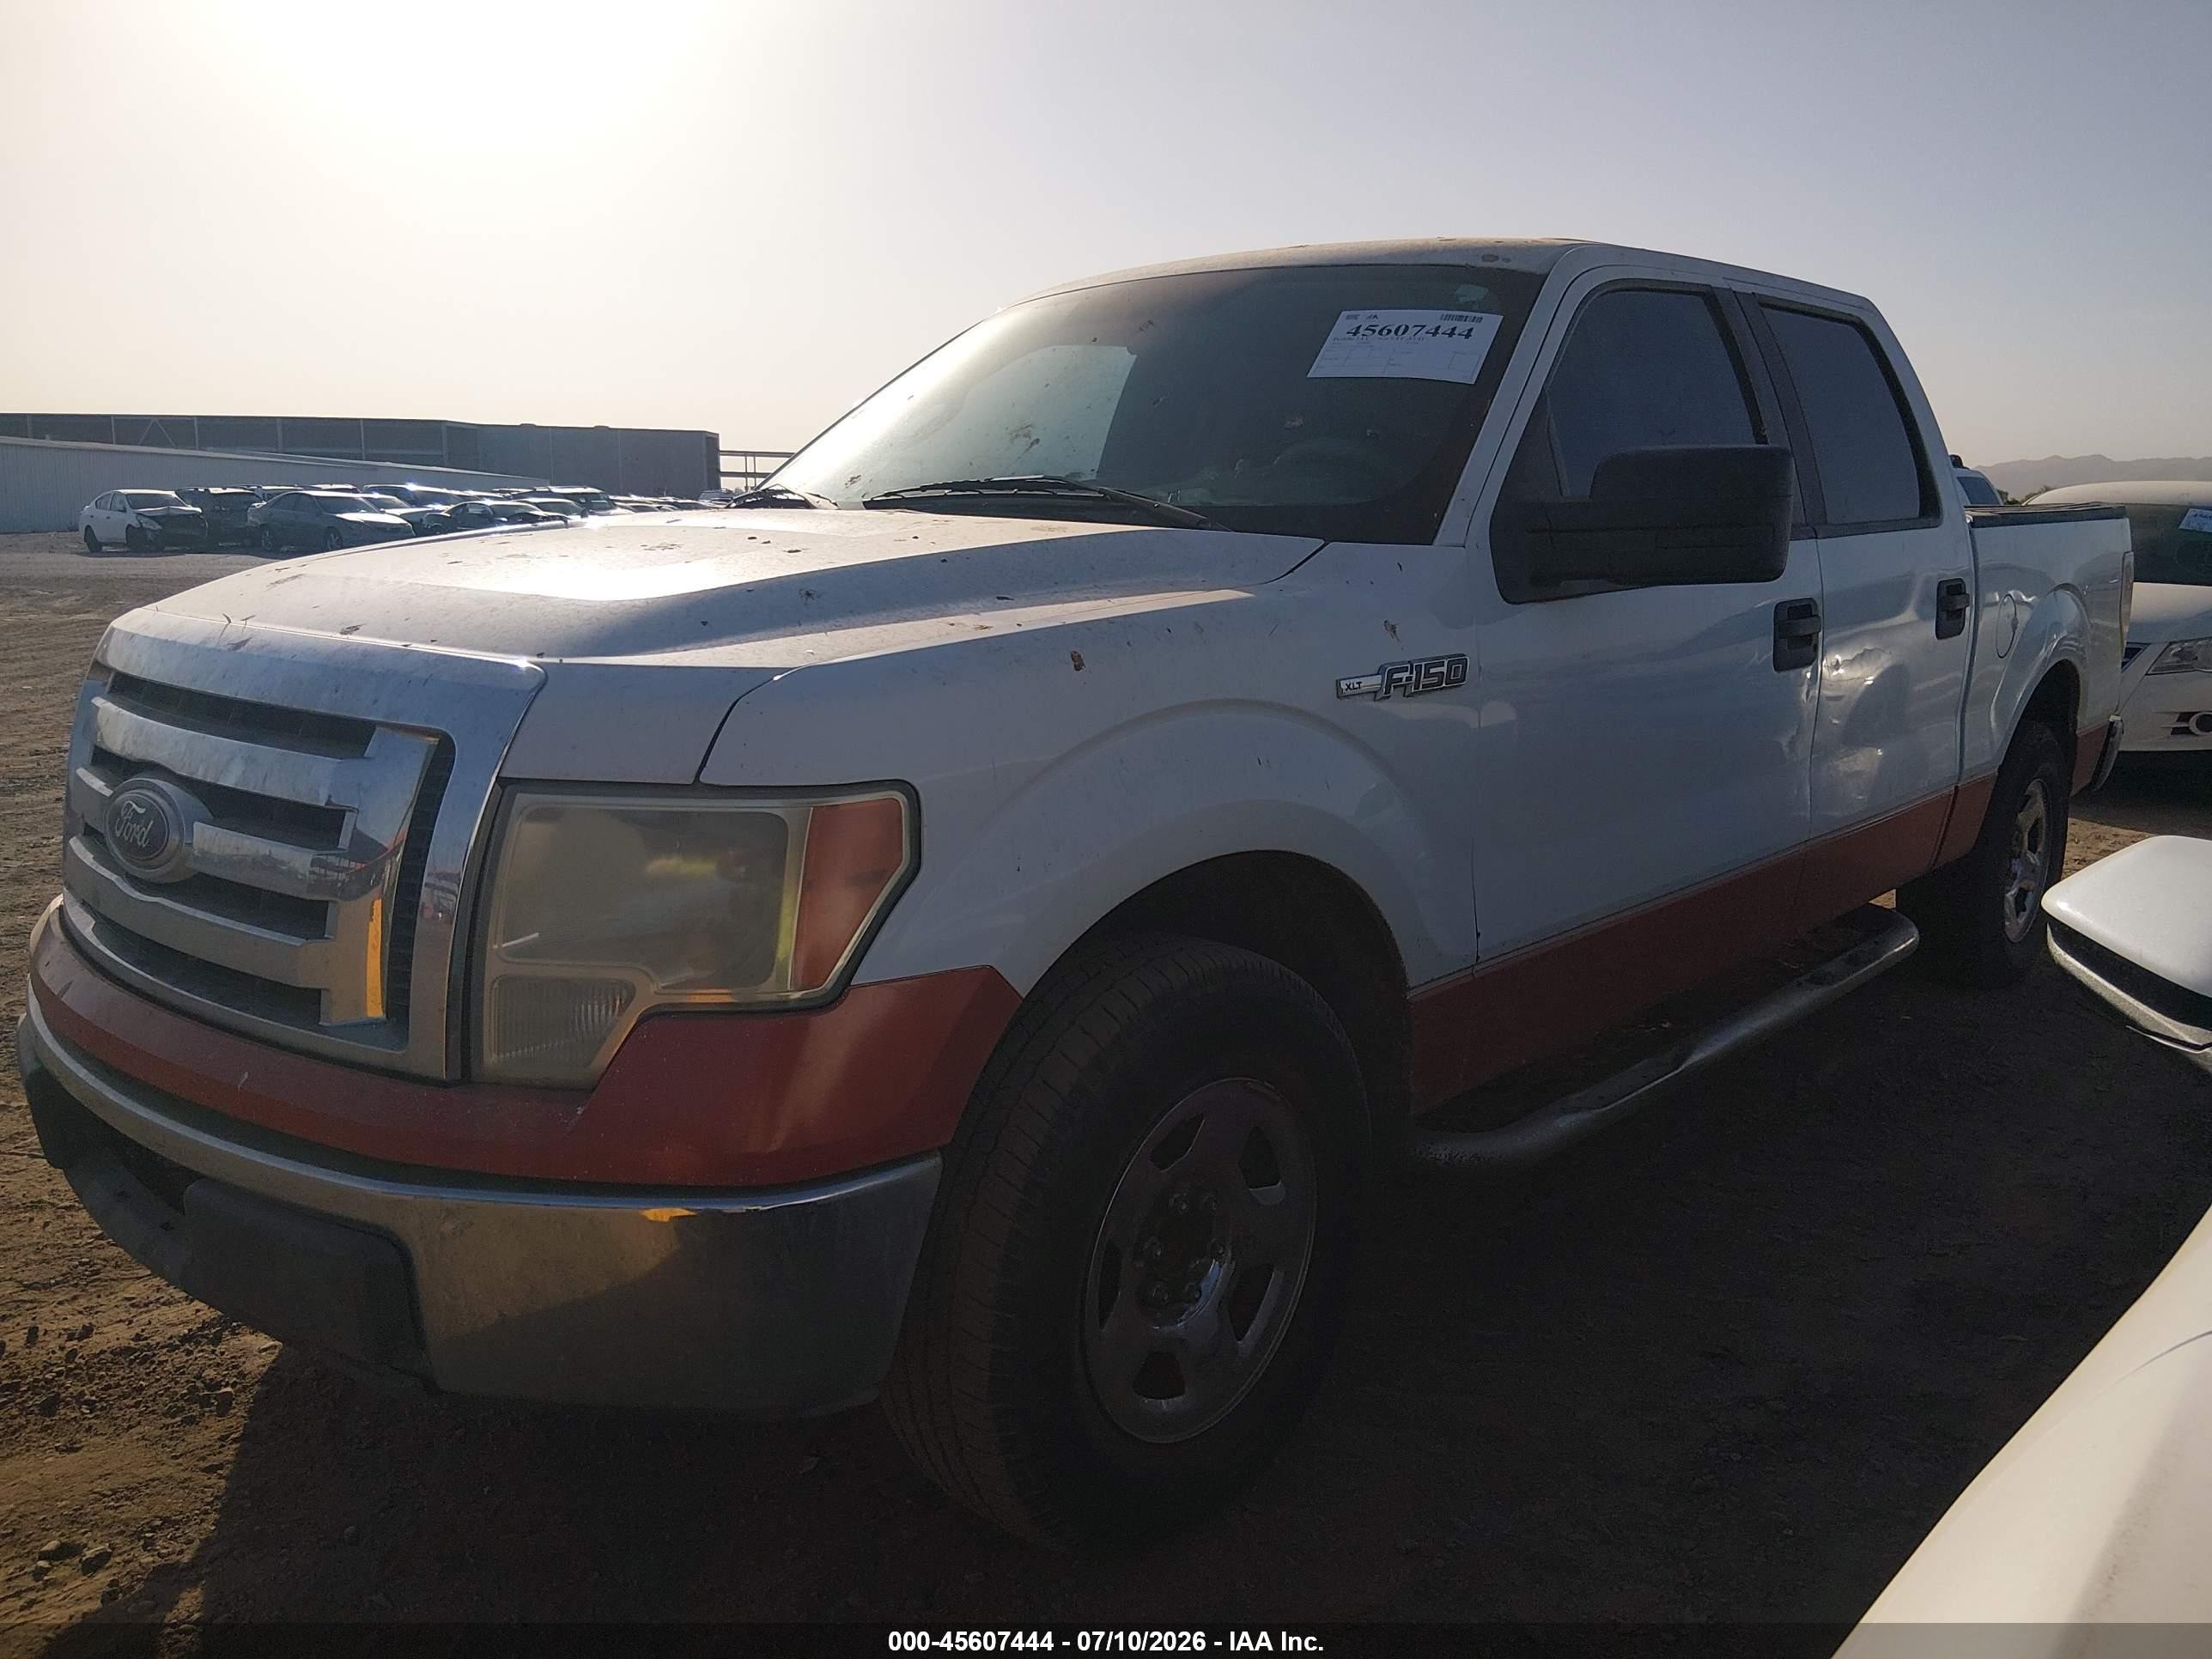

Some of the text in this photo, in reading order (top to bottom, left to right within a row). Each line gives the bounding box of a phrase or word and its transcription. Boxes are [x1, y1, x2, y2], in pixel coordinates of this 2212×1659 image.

[1346, 324, 1474, 340] 45607444
[1345, 656, 1470, 696] XLT F-150
[115, 800, 154, 848] Ford
